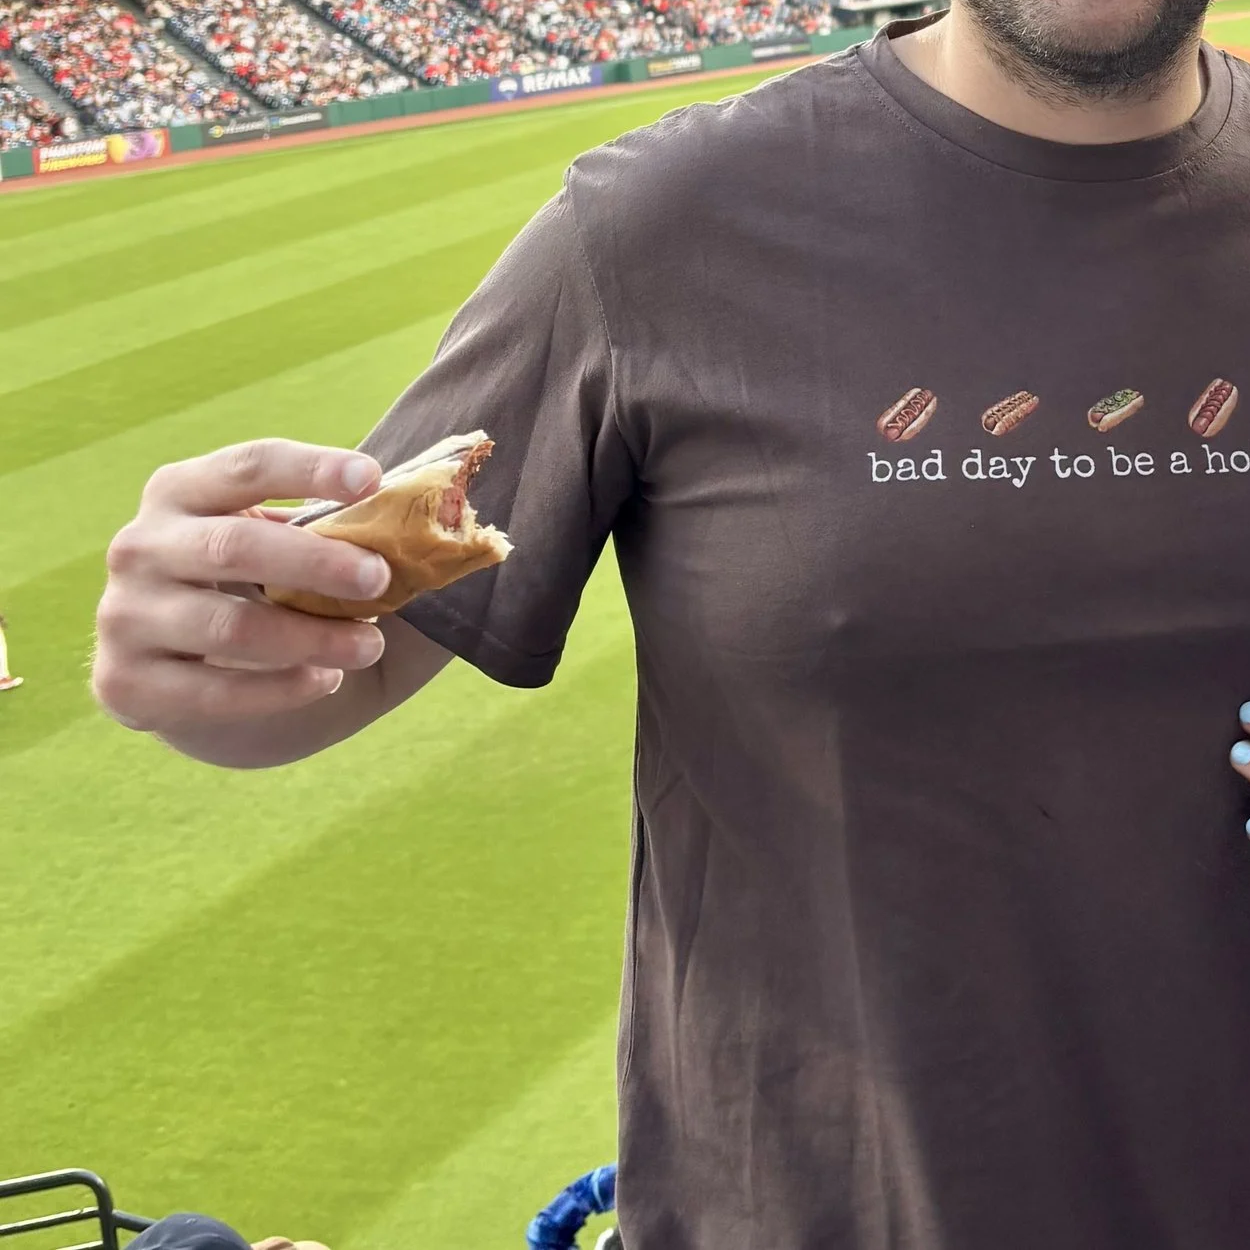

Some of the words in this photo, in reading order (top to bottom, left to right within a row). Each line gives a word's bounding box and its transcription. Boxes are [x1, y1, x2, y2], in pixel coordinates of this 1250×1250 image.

[522, 66, 591, 93] RE/MAX
[866, 450, 947, 483] bad
[961, 449, 1037, 488] day
[1049, 448, 1096, 478] to
[1107, 446, 1155, 477] be
[1169, 451, 1193, 474] a
